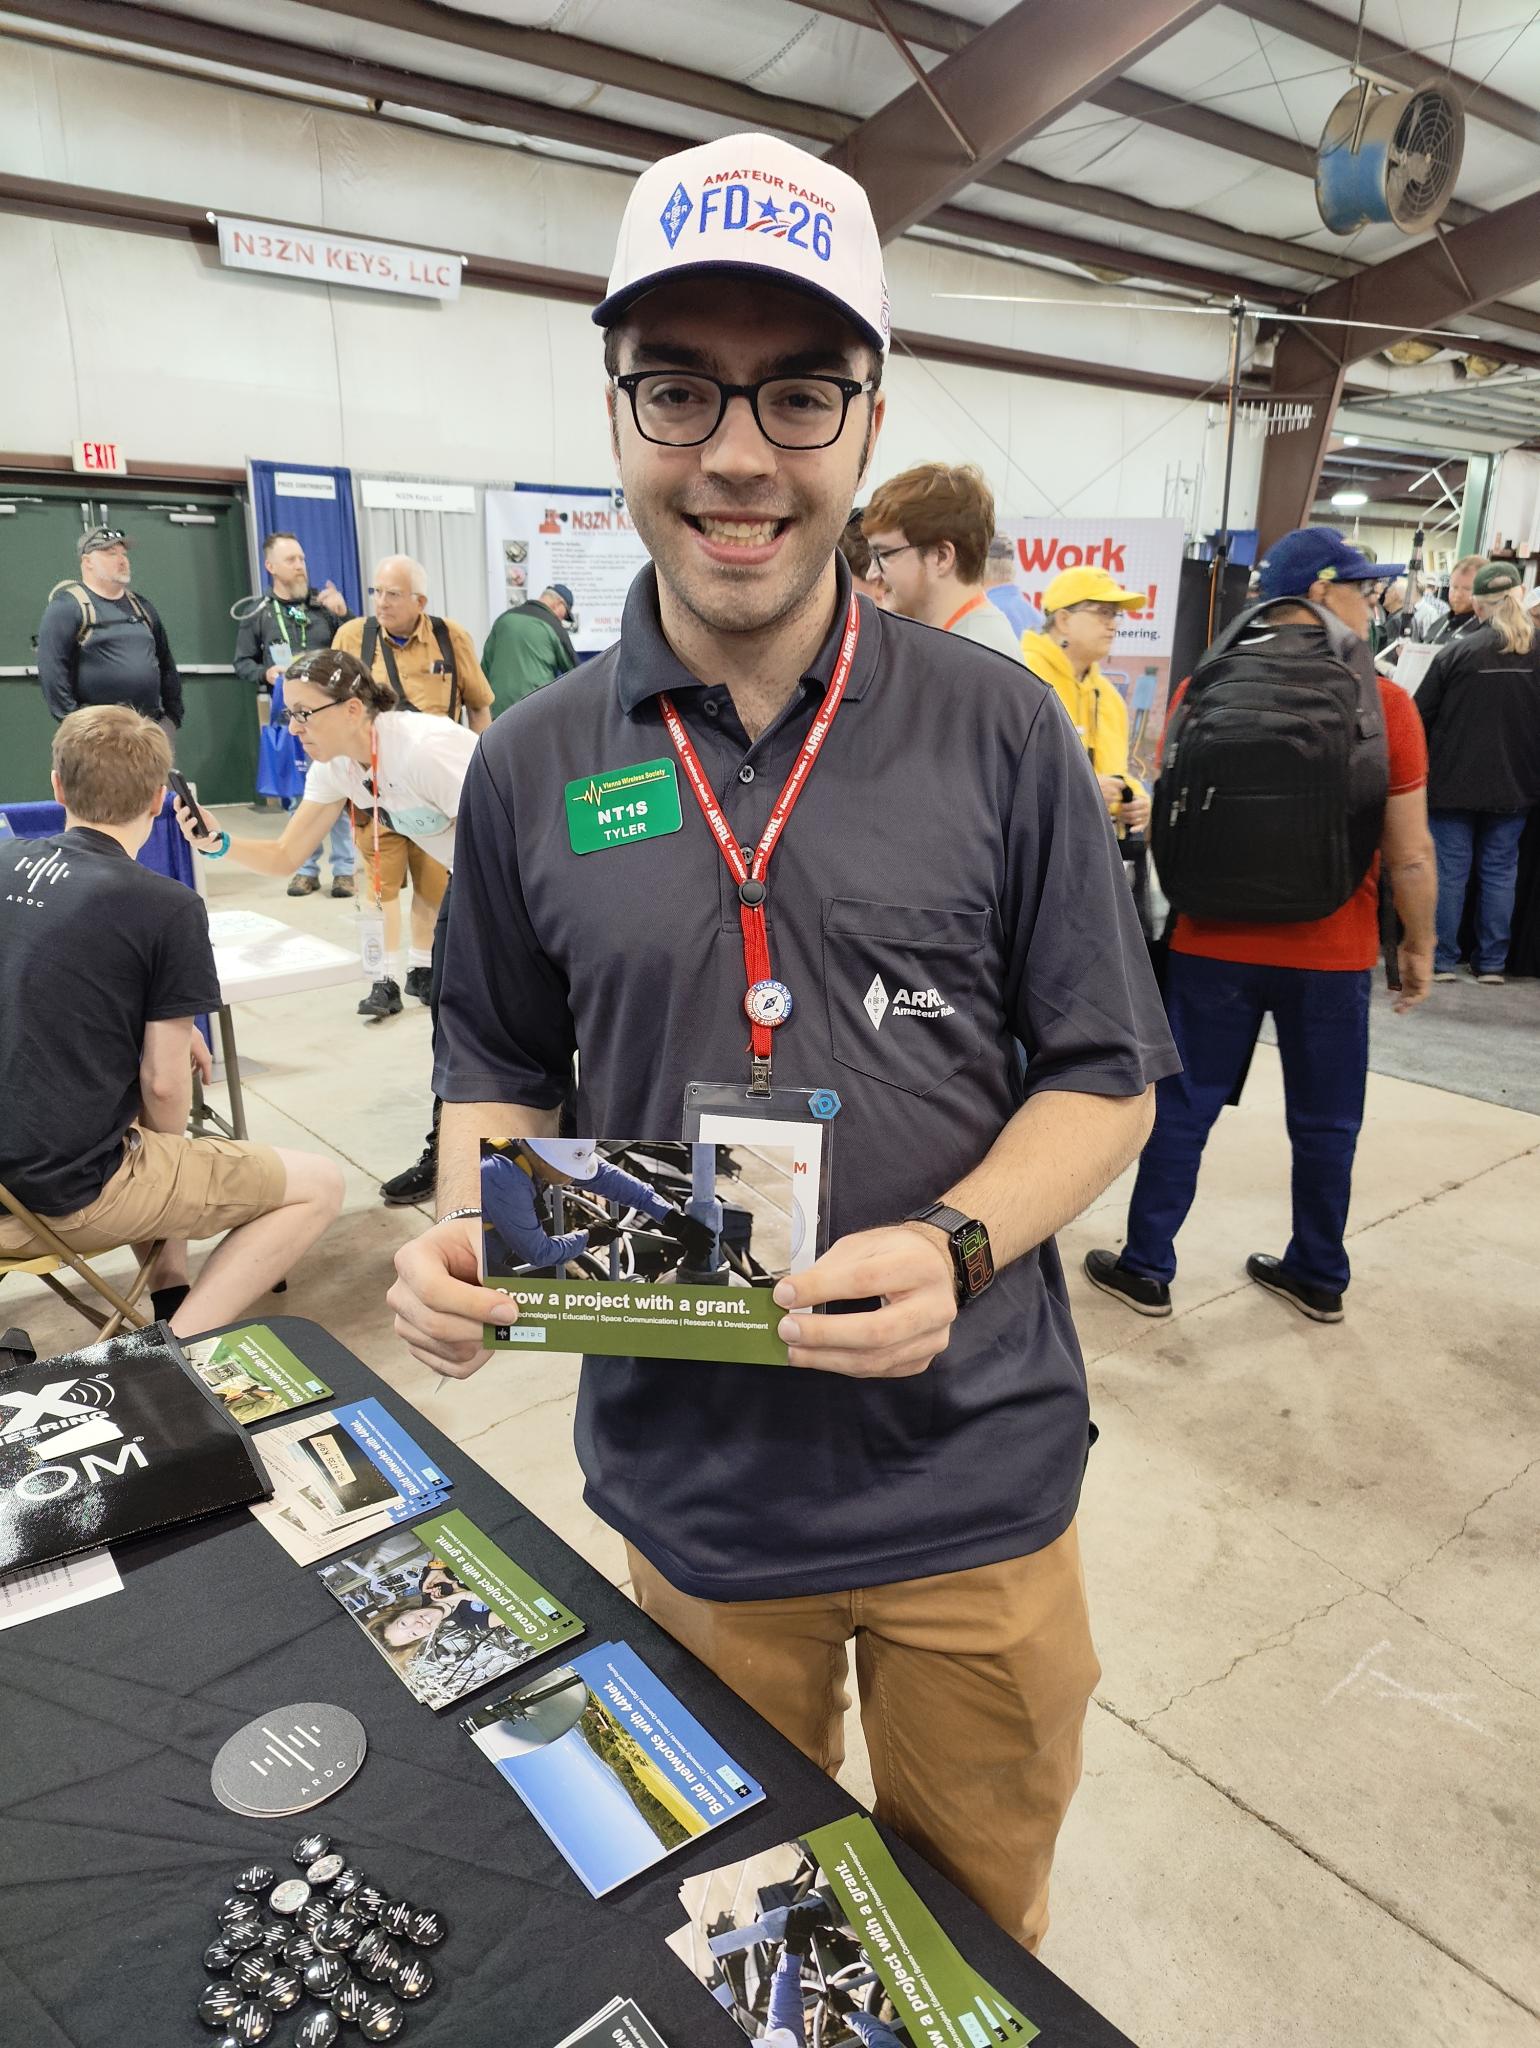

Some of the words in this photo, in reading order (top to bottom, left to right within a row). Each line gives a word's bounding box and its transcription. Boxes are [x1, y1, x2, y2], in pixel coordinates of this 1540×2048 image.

[703, 169, 784, 189] AMATEUR
[788, 182, 836, 214] RADIO
[699, 184, 750, 234] FD
[787, 201, 833, 262] 26
[234, 232, 315, 265] N3ZN
[326, 247, 398, 282] KEYS,
[410, 261, 450, 287] LLC
[84, 443, 116, 469] EXIT
[572, 510, 611, 529] N3ZN
[1017, 537, 1127, 572] Work
[1114, 629, 1161, 645] neering.
[759, 816, 783, 852] ARRL
[780, 780, 798, 810] Amateur
[794, 760, 808, 780] Radio
[805, 721, 828, 755] ARRL
[825, 684, 840, 714] Amateur
[836, 666, 846, 685] Radio
[842, 630, 856, 662] ARRL
[602, 780, 621, 790] Vienna
[621, 774, 645, 785] Wireless
[645, 768, 666, 780] Society
[668, 718, 687, 752] ARRL
[685, 756, 701, 784] Amateur
[697, 783, 710, 804] Radio
[707, 809, 730, 845] ARRL
[597, 800, 648, 825] NT1S
[604, 822, 647, 841] TYLER
[6, 894, 44, 908] ARDC
[892, 1006, 940, 1018] Amateur
[794, 1162, 807, 1174] M
[549, 1293, 560, 1306] a
[565, 1292, 630, 1312] project
[634, 1294, 674, 1310] with
[680, 1299, 690, 1312] a
[696, 1299, 750, 1316] grant.
[517, 1312, 557, 1320] echnologies
[624, 1316, 678, 1325] Communications
[684, 1319, 716, 1327] Research
[724, 1320, 768, 1330] Development
[365, 1436, 382, 1450] with
[377, 1450, 406, 1478] networks
[398, 1477, 420, 1495] Build
[435, 1535, 462, 1557] grant.
[462, 1562, 481, 1580] with
[476, 1578, 512, 1606] project
[512, 1612, 538, 1634] Grow
[603, 1680, 633, 1711] 44Net.
[630, 1711, 653, 1735] with
[650, 1734, 697, 1783] networks
[300, 1761, 346, 1795] ARDC
[690, 1782, 725, 1815] Build
[834, 1860, 868, 1902] grant.
[865, 1880, 883, 1906] Research
[859, 1904, 872, 1915] a
[865, 1917, 892, 1952] with
[879, 1908, 910, 1955] Communications
[907, 1954, 921, 1974] Space
[883, 1952, 930, 2012] project
[920, 1977, 941, 2007] Education
[920, 2014, 934, 2025] a
[936, 2010, 965, 2048] echnologies
